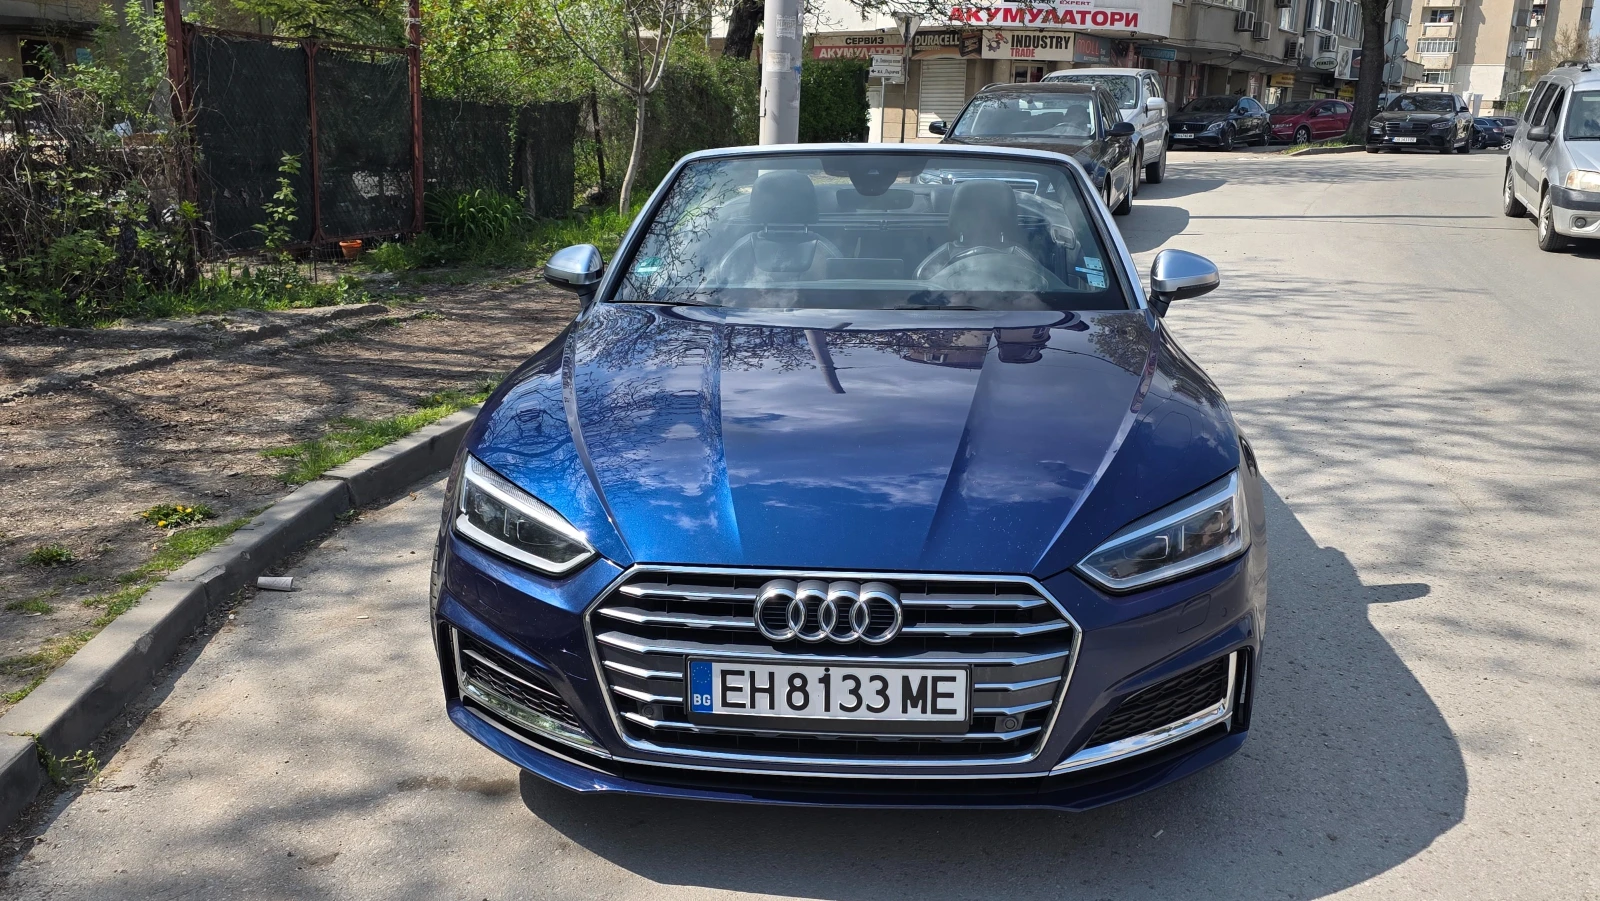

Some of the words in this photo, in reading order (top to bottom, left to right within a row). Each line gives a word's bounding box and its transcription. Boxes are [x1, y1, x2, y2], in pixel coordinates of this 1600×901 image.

[948, 7, 1139, 28] АКУМУЛАТОРИ
[845, 36, 885, 45] СЕРВИЗ
[914, 34, 960, 46] DURACELL
[1010, 34, 1071, 50] INDUSTRY
[1010, 47, 1036, 58] TRADE
[693, 693, 711, 707] BG
